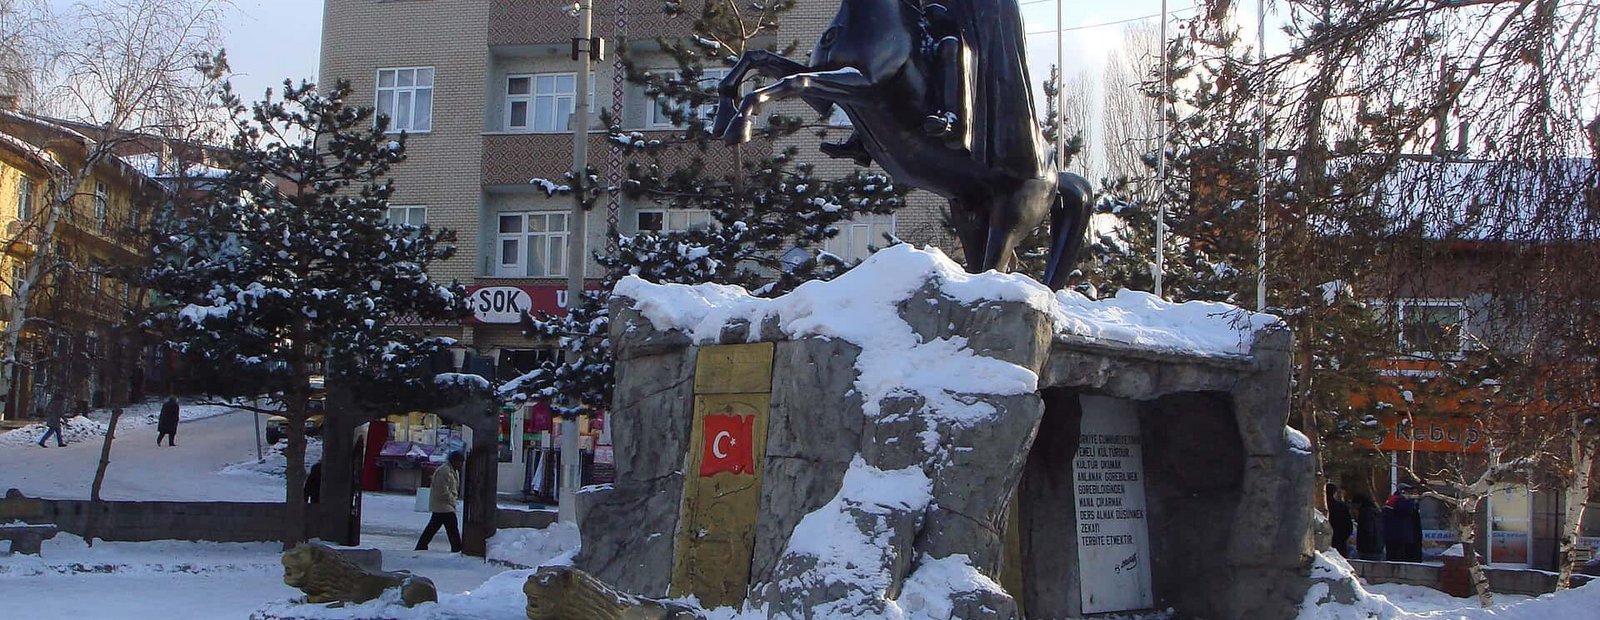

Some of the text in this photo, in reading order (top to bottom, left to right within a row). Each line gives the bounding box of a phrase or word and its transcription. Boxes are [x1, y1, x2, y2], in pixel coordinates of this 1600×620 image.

[479, 290, 520, 318] ŞOK
[1080, 510, 1095, 520] DERS
[1096, 510, 1115, 519] ALMAK
